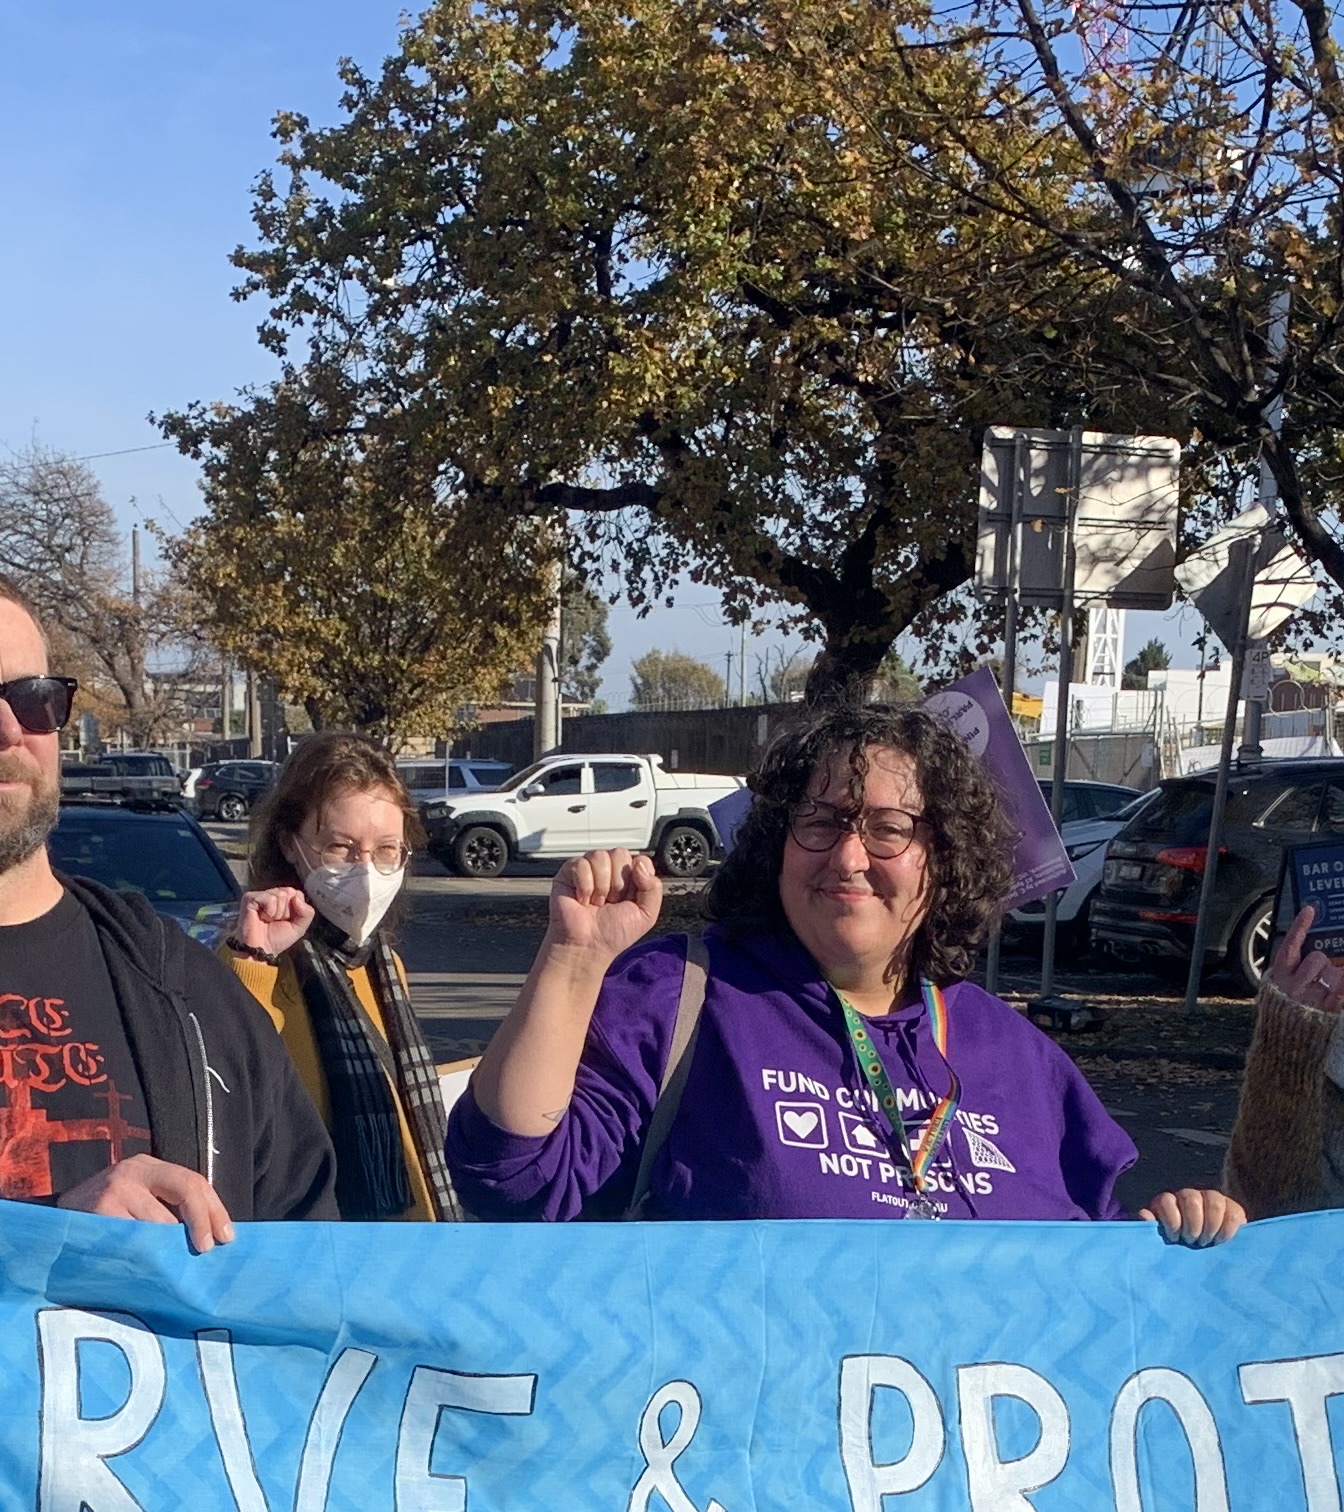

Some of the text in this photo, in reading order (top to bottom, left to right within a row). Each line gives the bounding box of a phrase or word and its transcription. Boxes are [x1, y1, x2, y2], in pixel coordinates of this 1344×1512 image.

[1252, 651, 1269, 662] 4P
[1302, 862, 1329, 876] BAR
[761, 1068, 830, 1101] FUND
[819, 1152, 872, 1180] NOT
